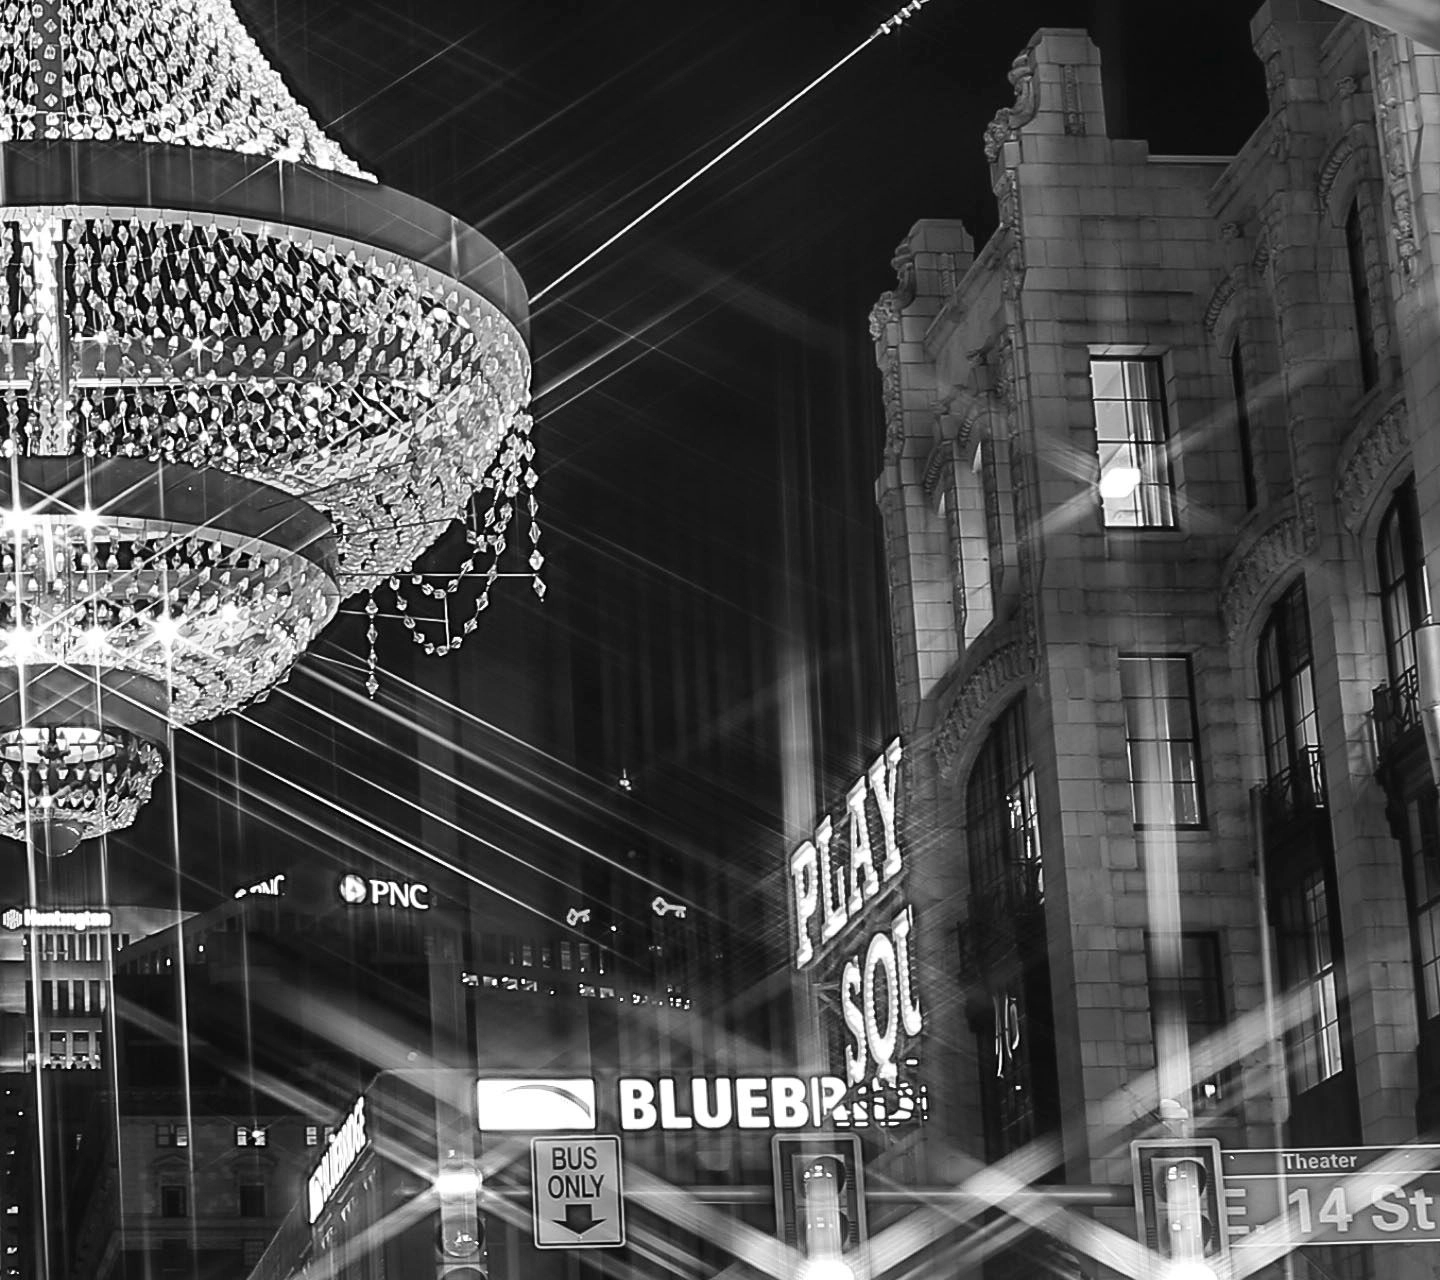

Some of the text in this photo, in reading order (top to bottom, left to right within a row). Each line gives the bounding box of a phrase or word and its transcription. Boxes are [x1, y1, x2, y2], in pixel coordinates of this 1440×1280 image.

[791, 736, 903, 970] PLAY
[369, 879, 429, 910] PNC
[551, 1146, 598, 1171] BUS
[1282, 1153, 1358, 1170] Theater
[547, 1173, 606, 1199] ONLY
[1288, 1186, 1353, 1234] 14
[1371, 1184, 1436, 1232] St
